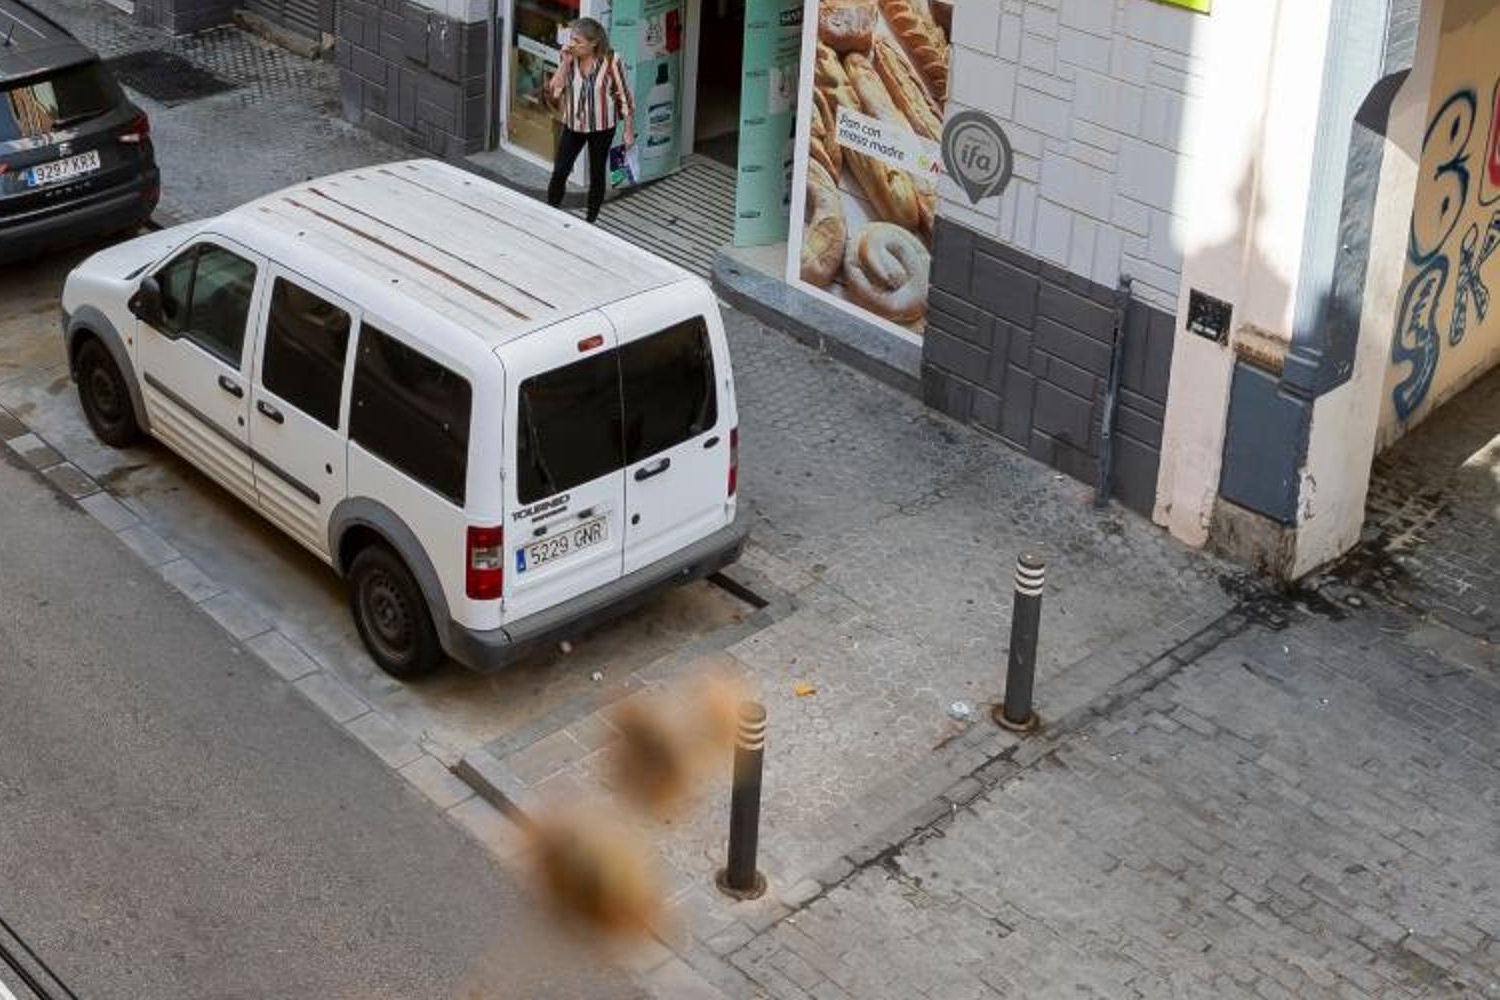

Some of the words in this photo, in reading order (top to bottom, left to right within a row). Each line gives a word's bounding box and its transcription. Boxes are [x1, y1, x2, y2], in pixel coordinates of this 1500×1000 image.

[839, 113, 861, 131] Pan
[861, 124, 881, 139] con
[839, 128, 868, 147] masa
[869, 140, 905, 161] madre
[961, 143, 991, 172] ifa
[530, 535, 569, 566] 5229
